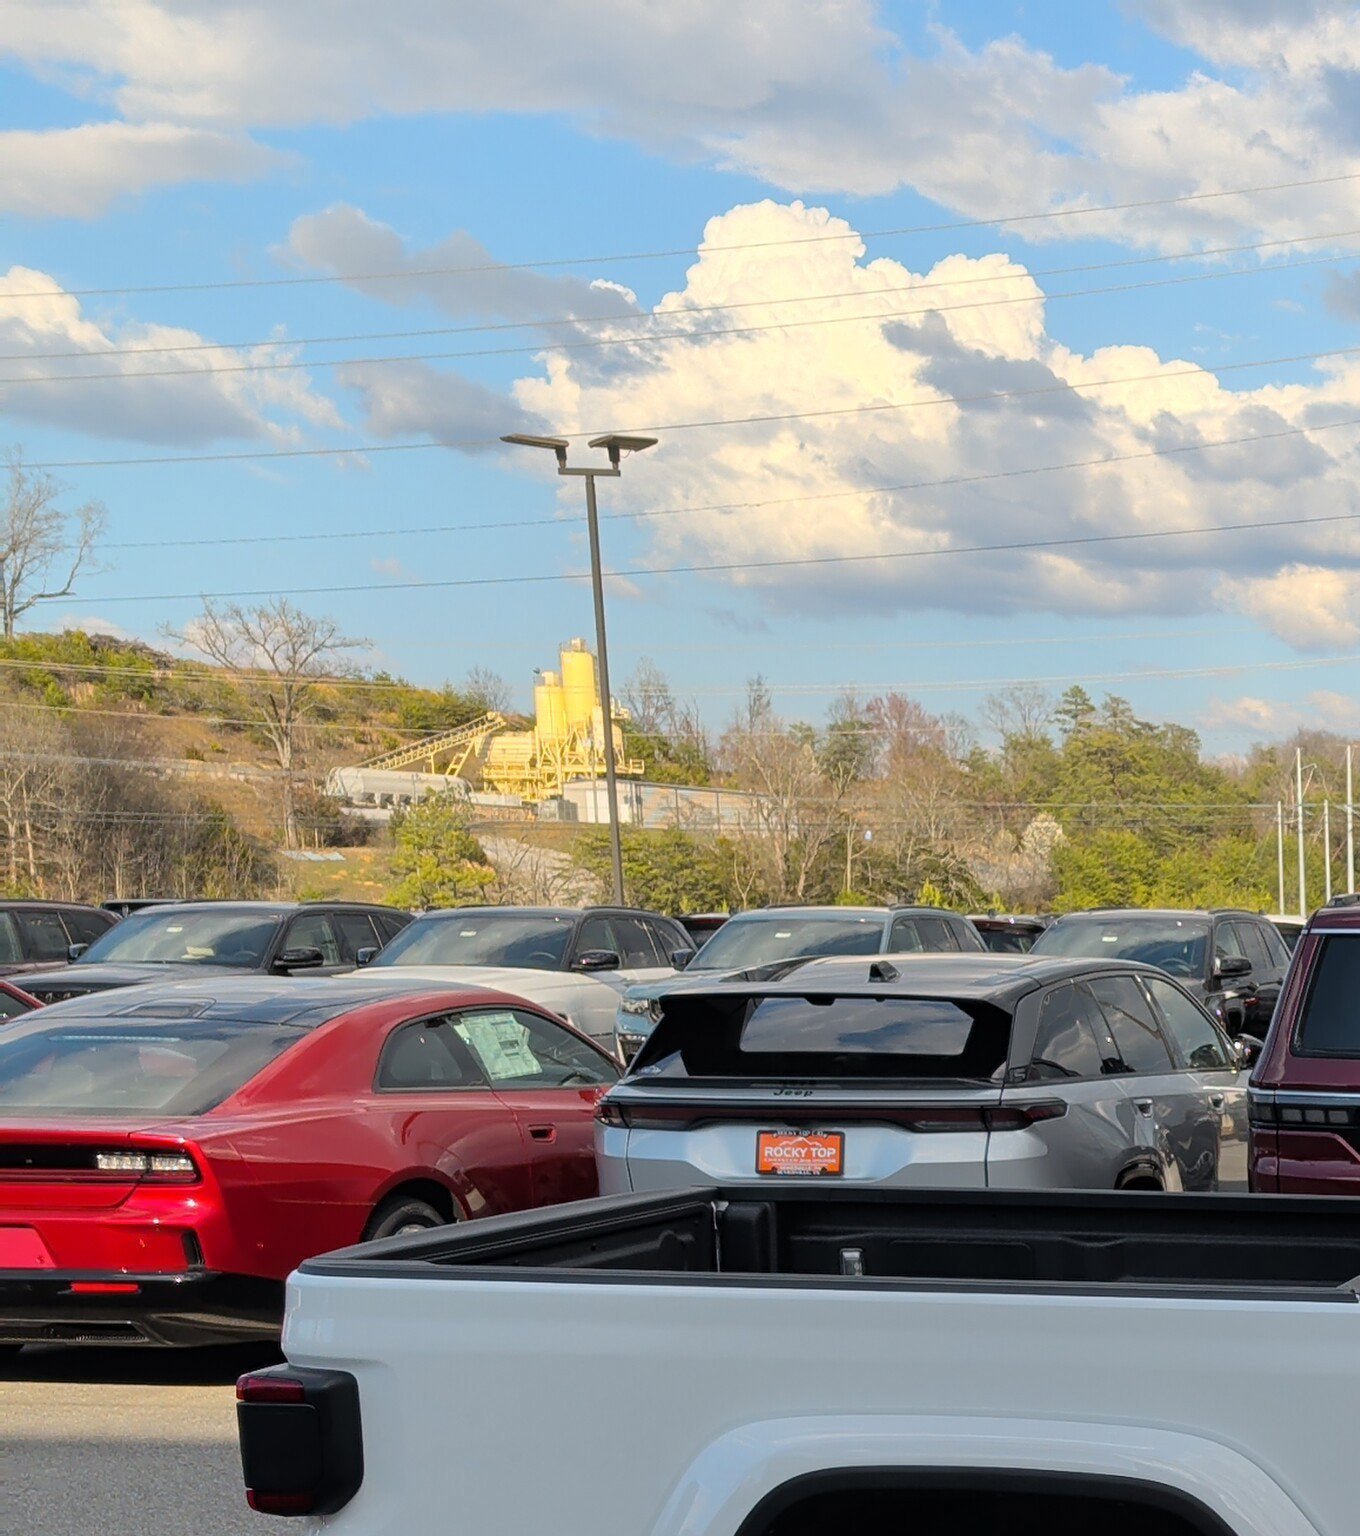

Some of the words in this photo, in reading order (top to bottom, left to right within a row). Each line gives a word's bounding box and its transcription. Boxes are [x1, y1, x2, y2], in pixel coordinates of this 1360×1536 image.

[773, 1086, 813, 1097] Jeep
[764, 1146, 808, 1158] ROCKY
[810, 1147, 837, 1158] TOP
